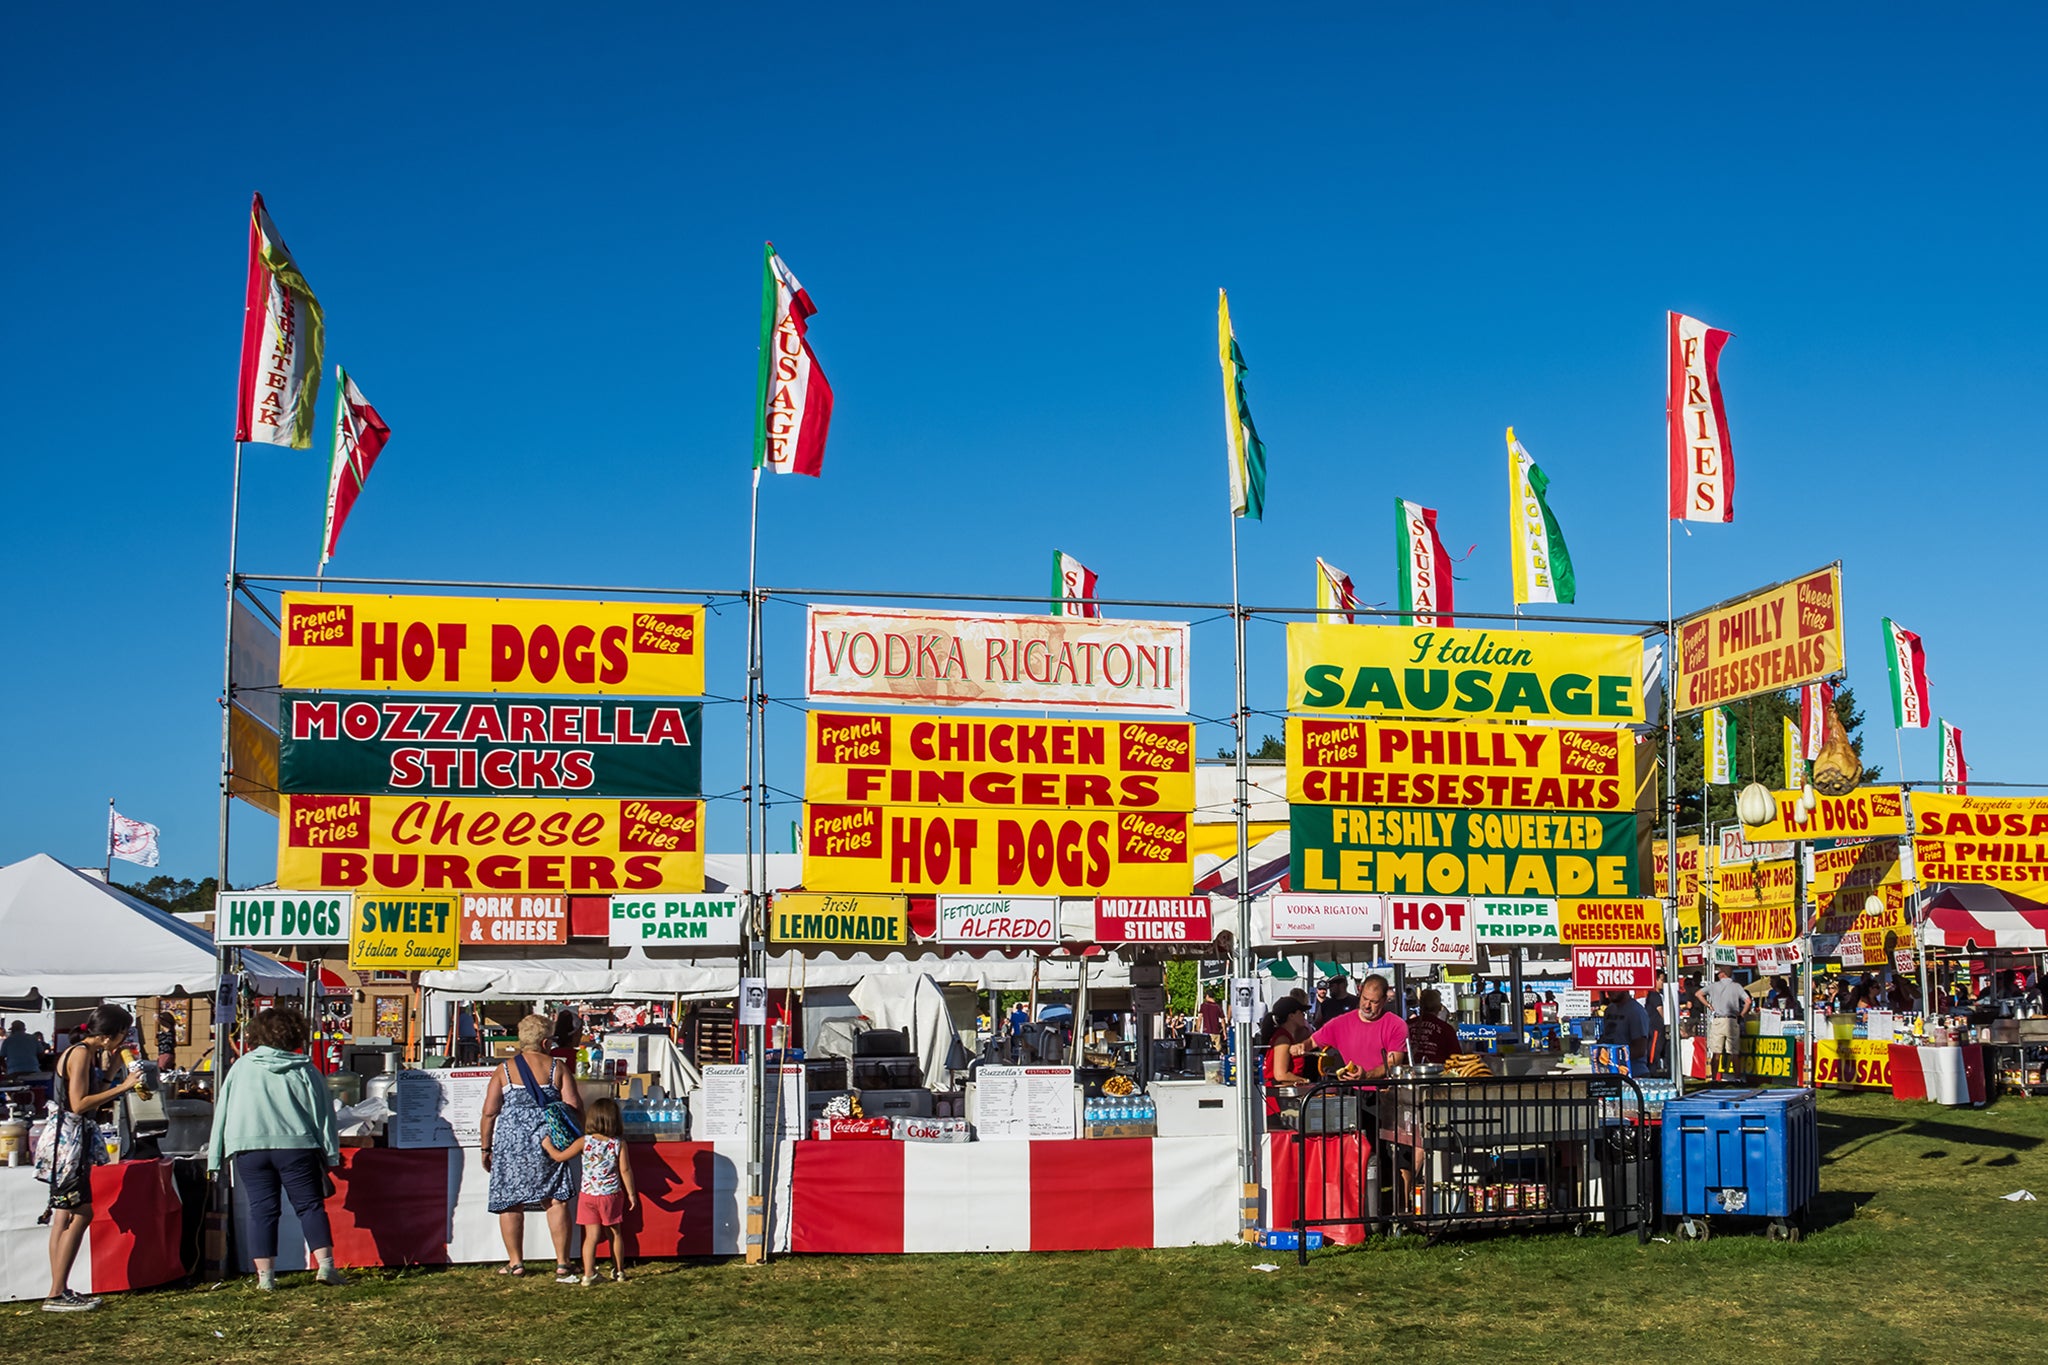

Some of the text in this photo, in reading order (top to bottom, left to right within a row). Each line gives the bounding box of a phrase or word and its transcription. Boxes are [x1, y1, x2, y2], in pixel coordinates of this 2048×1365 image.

[765, 279, 801, 464] AUSAGE
[1682, 337, 1718, 512] FRIES
[1412, 519, 1434, 627] SAUSAG
[1799, 583, 1833, 609] Cheese
[292, 605, 347, 631] French
[634, 614, 693, 640] Cheese
[1718, 596, 1785, 658] PHILLY
[1801, 607, 1827, 631] Fries
[302, 624, 345, 645] Fries
[637, 632, 679, 654] Fries
[360, 621, 629, 685] HOT DOGS
[821, 630, 1175, 690] VODKA RIGATONI
[1408, 632, 1534, 667] Italian
[1688, 634, 1825, 706] CHEESESTEAKS
[1895, 632, 1918, 723] SAUSAGE
[1302, 664, 1633, 717] SAUSAGE
[292, 700, 691, 747] MOZZARELLA
[821, 718, 883, 745] French
[1306, 722, 1360, 748] French
[833, 740, 881, 763] Fries
[909, 721, 1106, 765] CHICKEN
[1122, 724, 1189, 755] Cheese
[1378, 728, 1548, 769] PHILLY
[1561, 731, 1617, 761] Cheese
[389, 747, 595, 789] STICKS
[1126, 743, 1175, 771] Fries
[1316, 744, 1358, 766] Fries
[1565, 752, 1605, 776] Fries
[846, 768, 1160, 808] FINGERS
[1302, 770, 1620, 810] CHEESESTEAKS
[294, 798, 361, 829] French
[390, 800, 606, 846] Cheese
[622, 801, 696, 834] Cheese
[813, 807, 874, 837] French
[1781, 798, 1869, 833] HT DOGS
[307, 821, 358, 846] Fries
[627, 823, 680, 850] Fries
[1120, 813, 1187, 845] Cheese
[1332, 808, 1604, 850] FRESHLY SQUEEZED
[825, 832, 872, 856] Fries
[890, 816, 1111, 888] HOT DOGS
[1125, 835, 1173, 862] Fries
[1829, 843, 1884, 869] CHICKEN
[320, 853, 664, 890] BURGERS
[1303, 848, 1629, 897] LEMONADE
[1721, 872, 1754, 892] ITALIAN
[1773, 866, 1794, 887] DOGS
[361, 901, 450, 933] SWEET
[464, 897, 565, 918] PORK ROLL
[612, 901, 736, 919] EGG PLANT
[821, 896, 859, 912] Fresh
[943, 899, 1011, 920] FETTUCCINE
[1102, 899, 1207, 918] MOZZARELLA
[1287, 905, 1369, 916] VODKA RIGATONI
[1393, 902, 1466, 932] HOT
[1484, 903, 1549, 916] TRIPE
[1577, 904, 1645, 920] CHICKEN
[229, 900, 341, 937] HOT DOGS
[469, 920, 558, 941] & CHEESE
[642, 921, 708, 939] PARM
[780, 914, 898, 941] LEMONADE
[960, 917, 1051, 939] ALFREDO
[1124, 921, 1186, 940] STICKS
[1476, 924, 1558, 937] TRIPPA
[1562, 923, 1661, 940] CHEESESTEAKS
[1721, 909, 1767, 941] BUTTERFLY
[1768, 906, 1793, 940] FRIES
[356, 939, 451, 965] Italian Sausage
[1392, 936, 1471, 960] Italian Sausage
[1578, 952, 1651, 968] MOZZARELLA
[1756, 948, 1773, 961] HOT
[1596, 969, 1634, 985] STICKS
[907, 1125, 941, 1139] Coke
